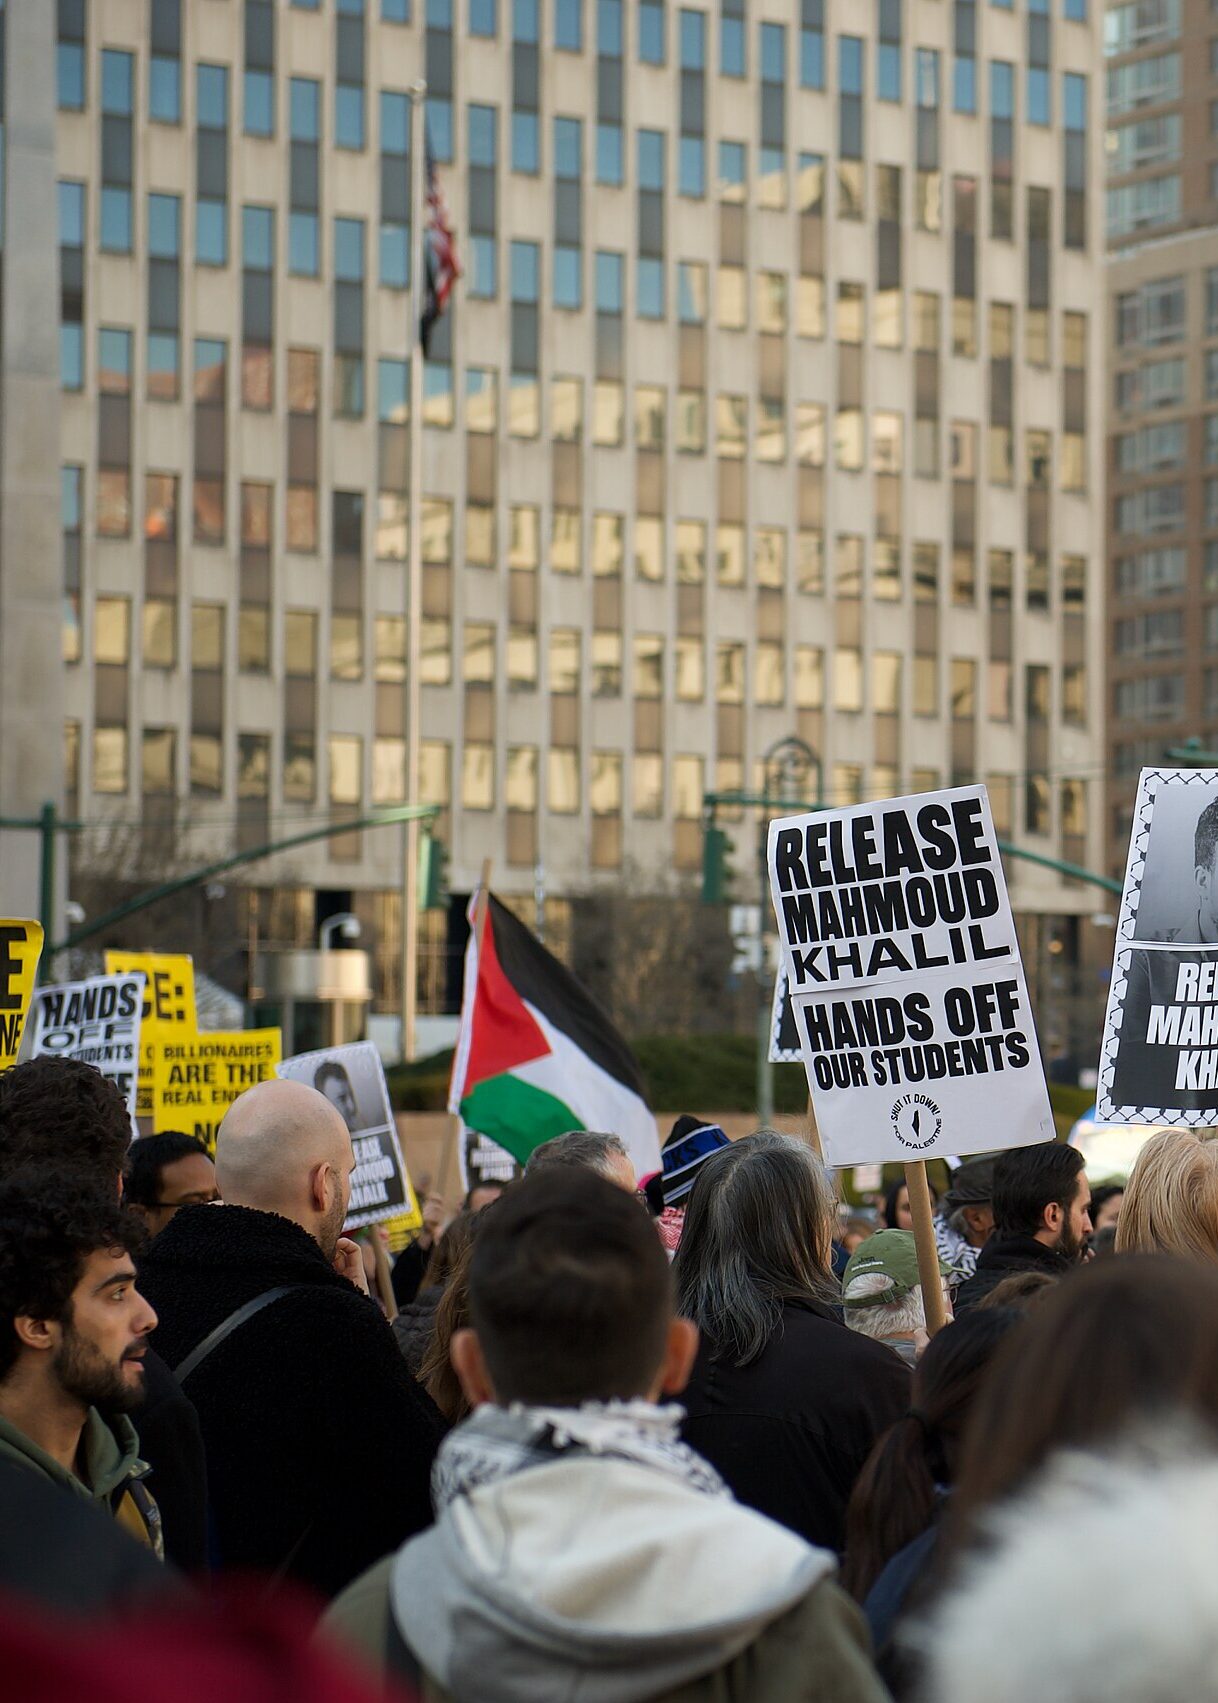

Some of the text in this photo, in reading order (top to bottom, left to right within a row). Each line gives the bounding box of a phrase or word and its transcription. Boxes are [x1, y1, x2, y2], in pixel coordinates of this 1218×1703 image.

[776, 798, 991, 892] RELEASE
[782, 868, 999, 945] MAHMOUD
[792, 924, 1010, 984] KHALIL
[43, 982, 138, 1027] HANDS
[804, 979, 1020, 1052] HANDS OFF
[42, 1023, 133, 1049] OFF
[168, 1063, 216, 1085] ARE
[225, 1062, 269, 1083] THE
[814, 1032, 1029, 1091] OUR STUDENTS
[163, 1090, 205, 1105] REAL
[891, 1094, 941, 1121] SHUT IT DOWN!
[893, 1118, 942, 1149] FOR PALESTINE
